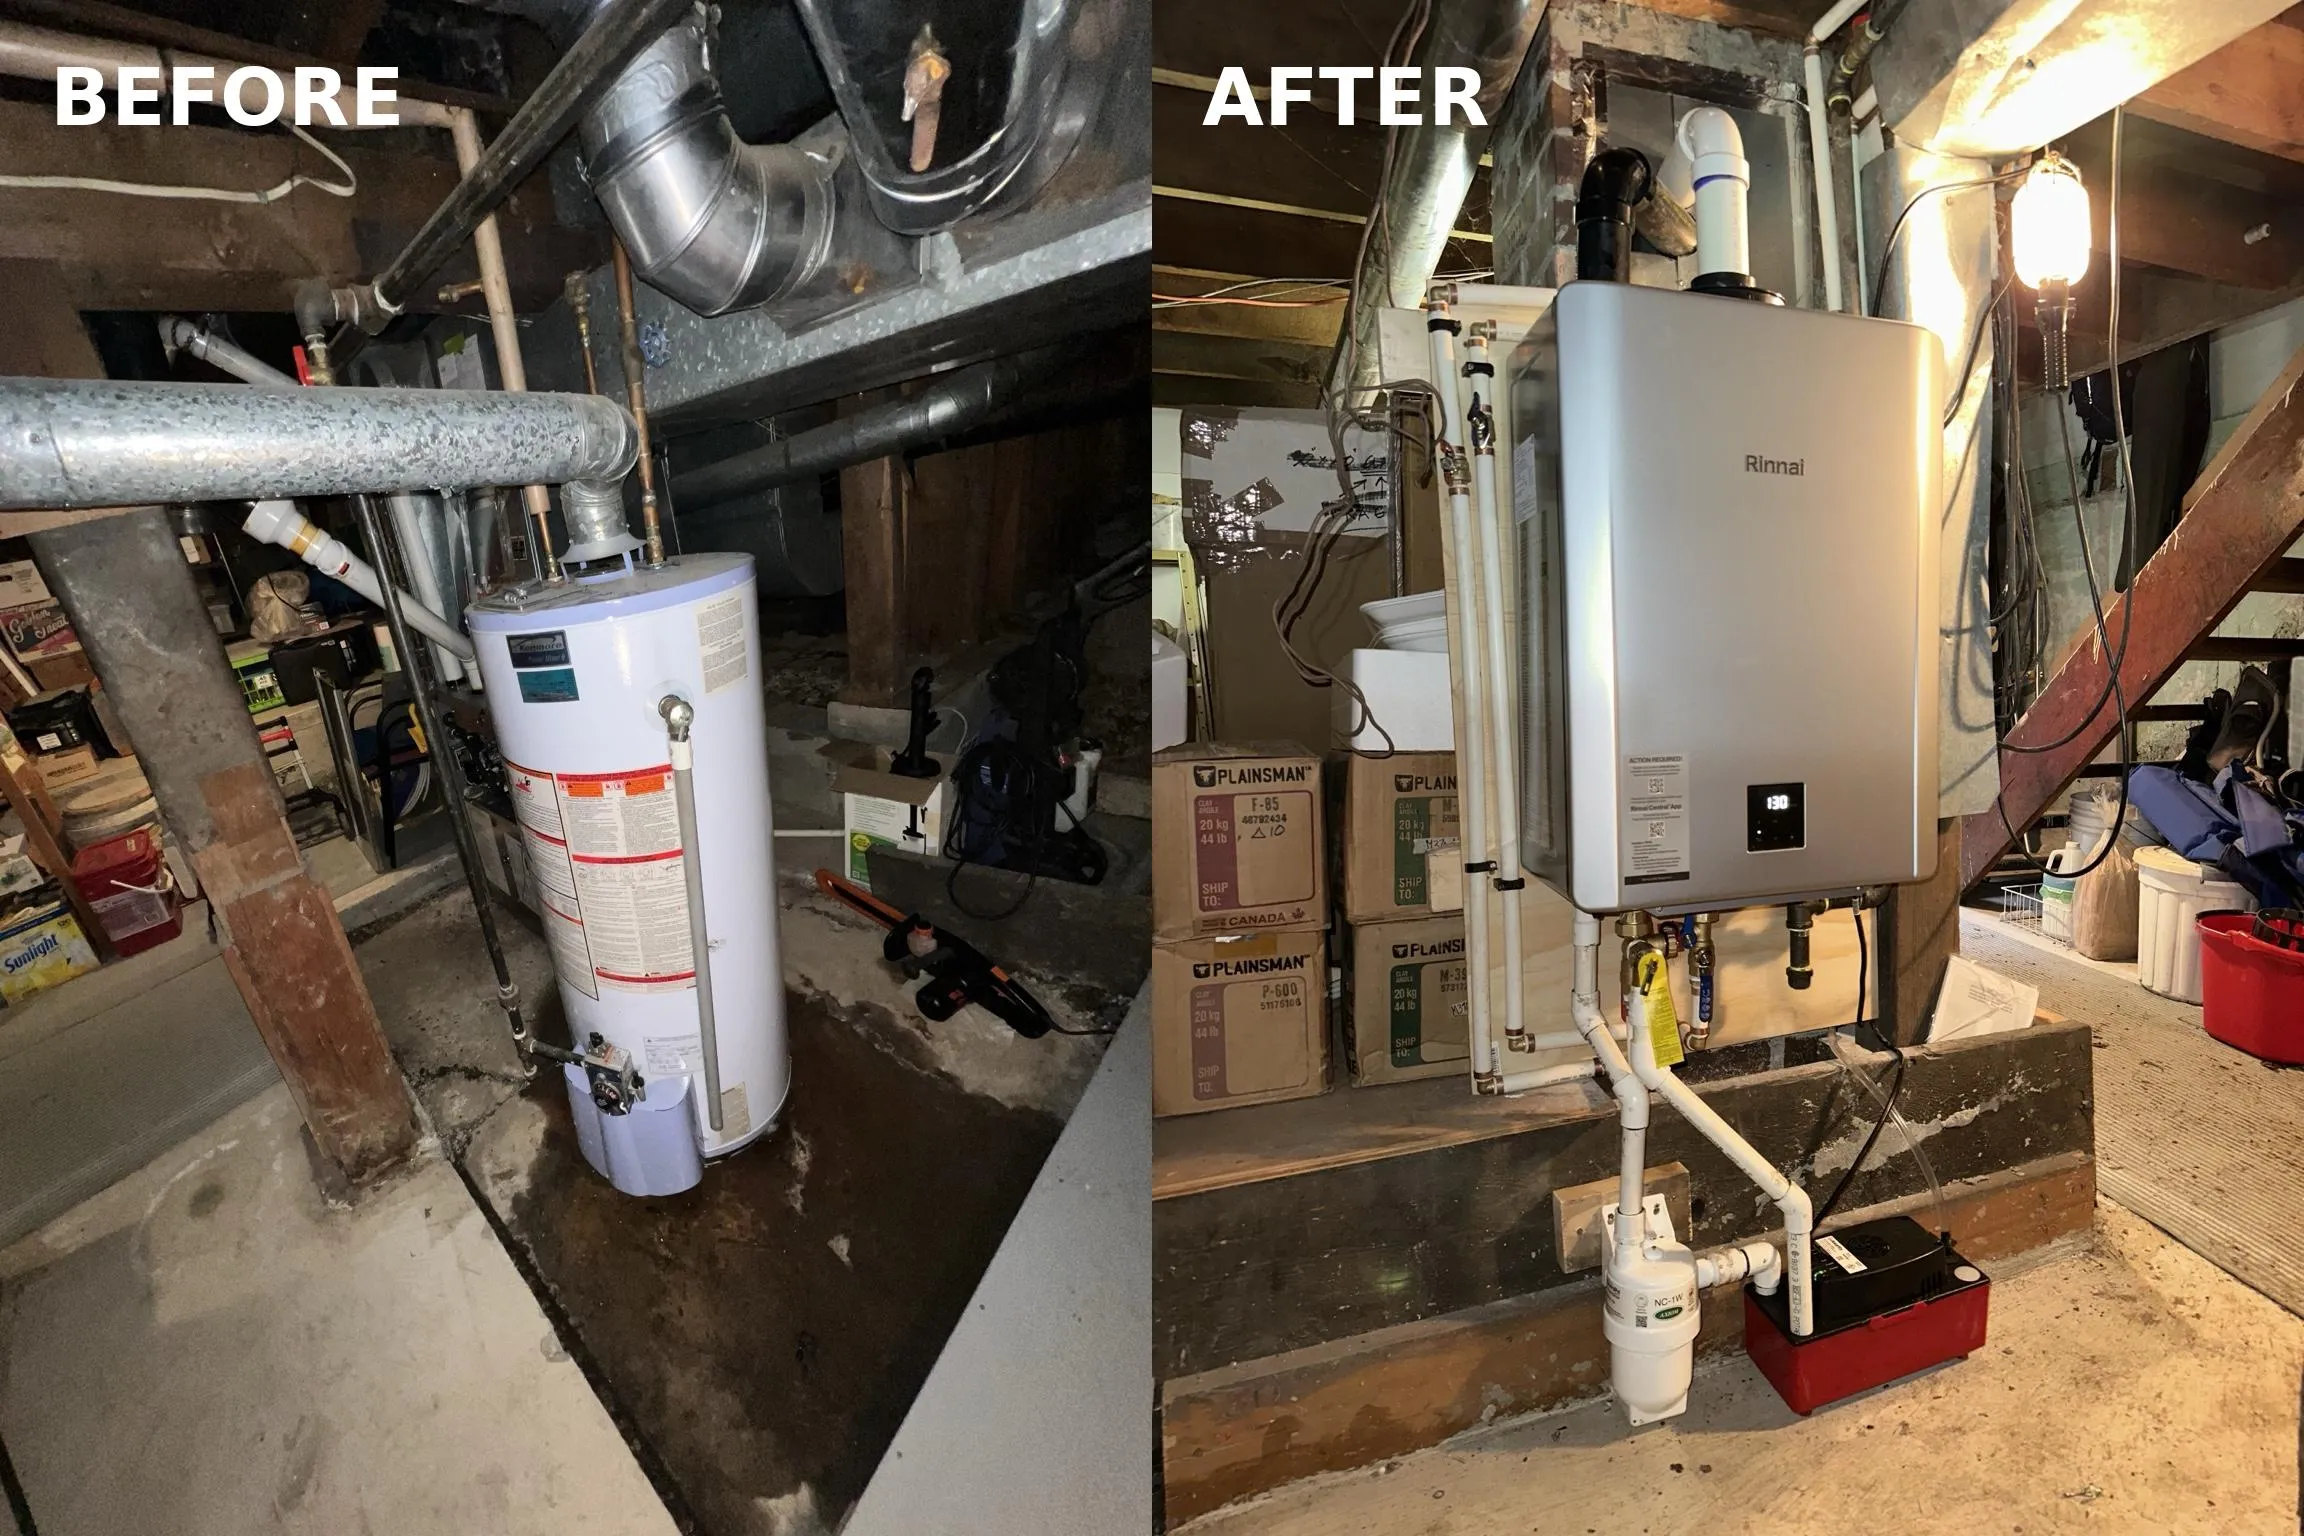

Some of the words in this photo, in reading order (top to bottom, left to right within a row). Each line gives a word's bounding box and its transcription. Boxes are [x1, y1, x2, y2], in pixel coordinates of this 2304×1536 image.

[1745, 454, 1805, 476] Rinnai
[1217, 766, 1306, 785] PLAINSMAN
[1251, 796, 1280, 812] F-85
[1766, 794, 1789, 810] 130
[1200, 819, 1213, 831] 20
[1216, 819, 1229, 831] kg
[1399, 820, 1411, 830] 20
[1413, 820, 1425, 831] kg
[1200, 833, 1214, 845] 44
[1217, 833, 1228, 844] lb
[1399, 831, 1411, 841] 44
[1202, 882, 1229, 895] SHIP
[1399, 876, 1423, 888] SHIP
[1399, 888, 1415, 900] TO:
[1202, 895, 1222, 907] TO:
[1228, 912, 1287, 926] CANADA
[4, 934, 59, 974] Sunlight
[1410, 938, 1465, 957] PLAINS
[1213, 955, 1305, 977] PLAINSMAN
[1262, 982, 1298, 999] P-600
[1394, 989, 1405, 999] 20
[1406, 988, 1417, 1000] kg
[1394, 1002, 1405, 1012] 44
[1407, 1001, 1416, 1010] lb
[1195, 1011, 1207, 1023] 20
[1208, 1010, 1220, 1022] kg
[1195, 1027, 1207, 1039] 44
[1395, 1037, 1416, 1048] SHIP
[1395, 1048, 1410, 1058] TO:
[1198, 1065, 1220, 1079] SHIP
[1654, 1292, 1684, 1307] NC-1W
